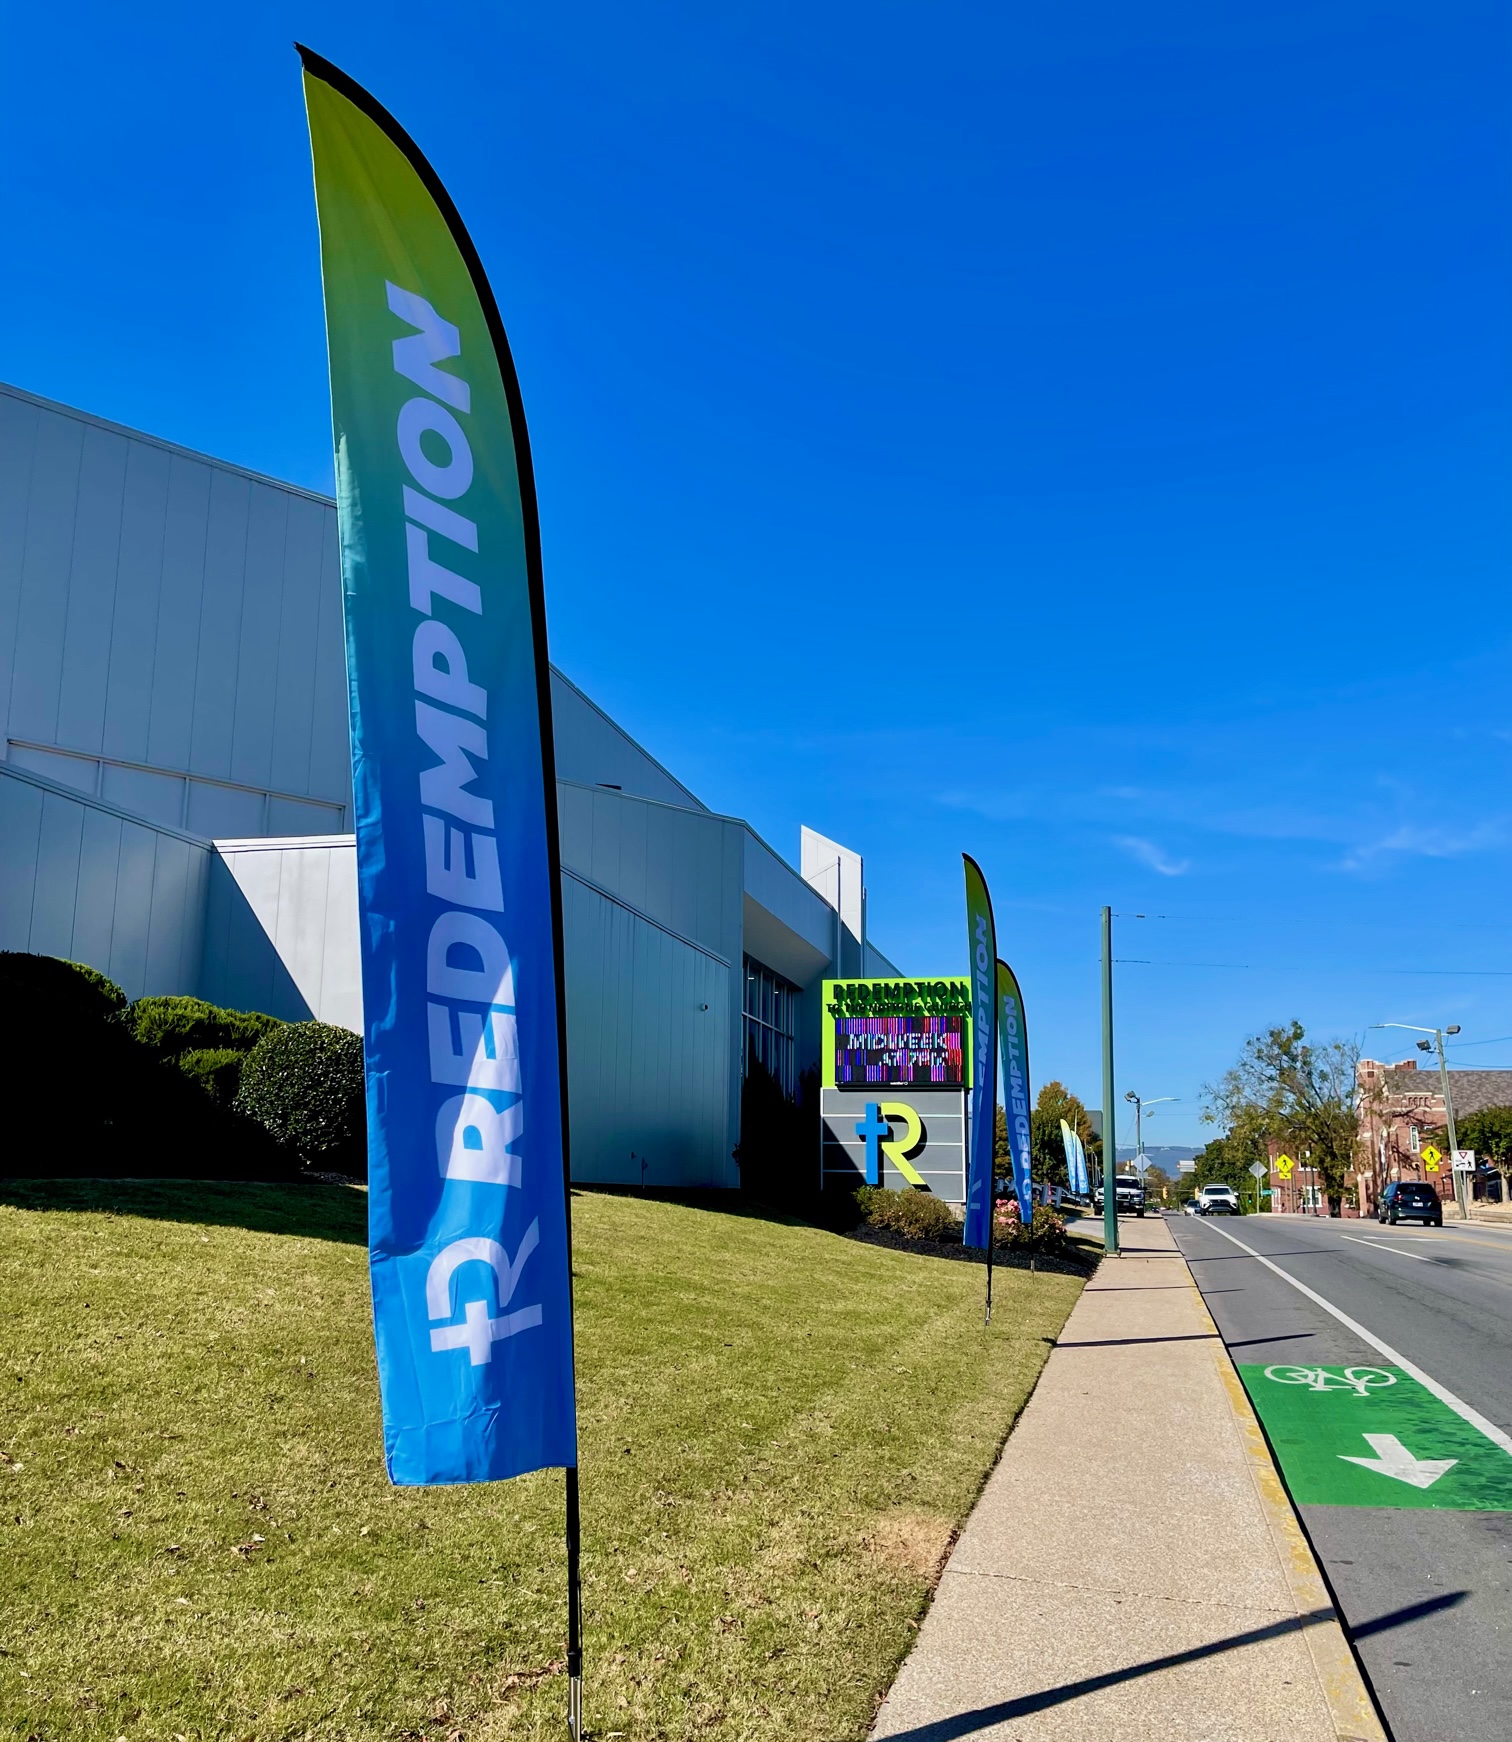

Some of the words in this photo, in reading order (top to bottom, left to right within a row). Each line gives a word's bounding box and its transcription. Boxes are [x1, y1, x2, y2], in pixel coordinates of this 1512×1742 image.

[385, 279, 524, 1189] REDEMPTION
[833, 981, 964, 1001] REDEMPTION
[826, 1003, 841, 1013] TO
[847, 1032, 948, 1050] MIDWEEK
